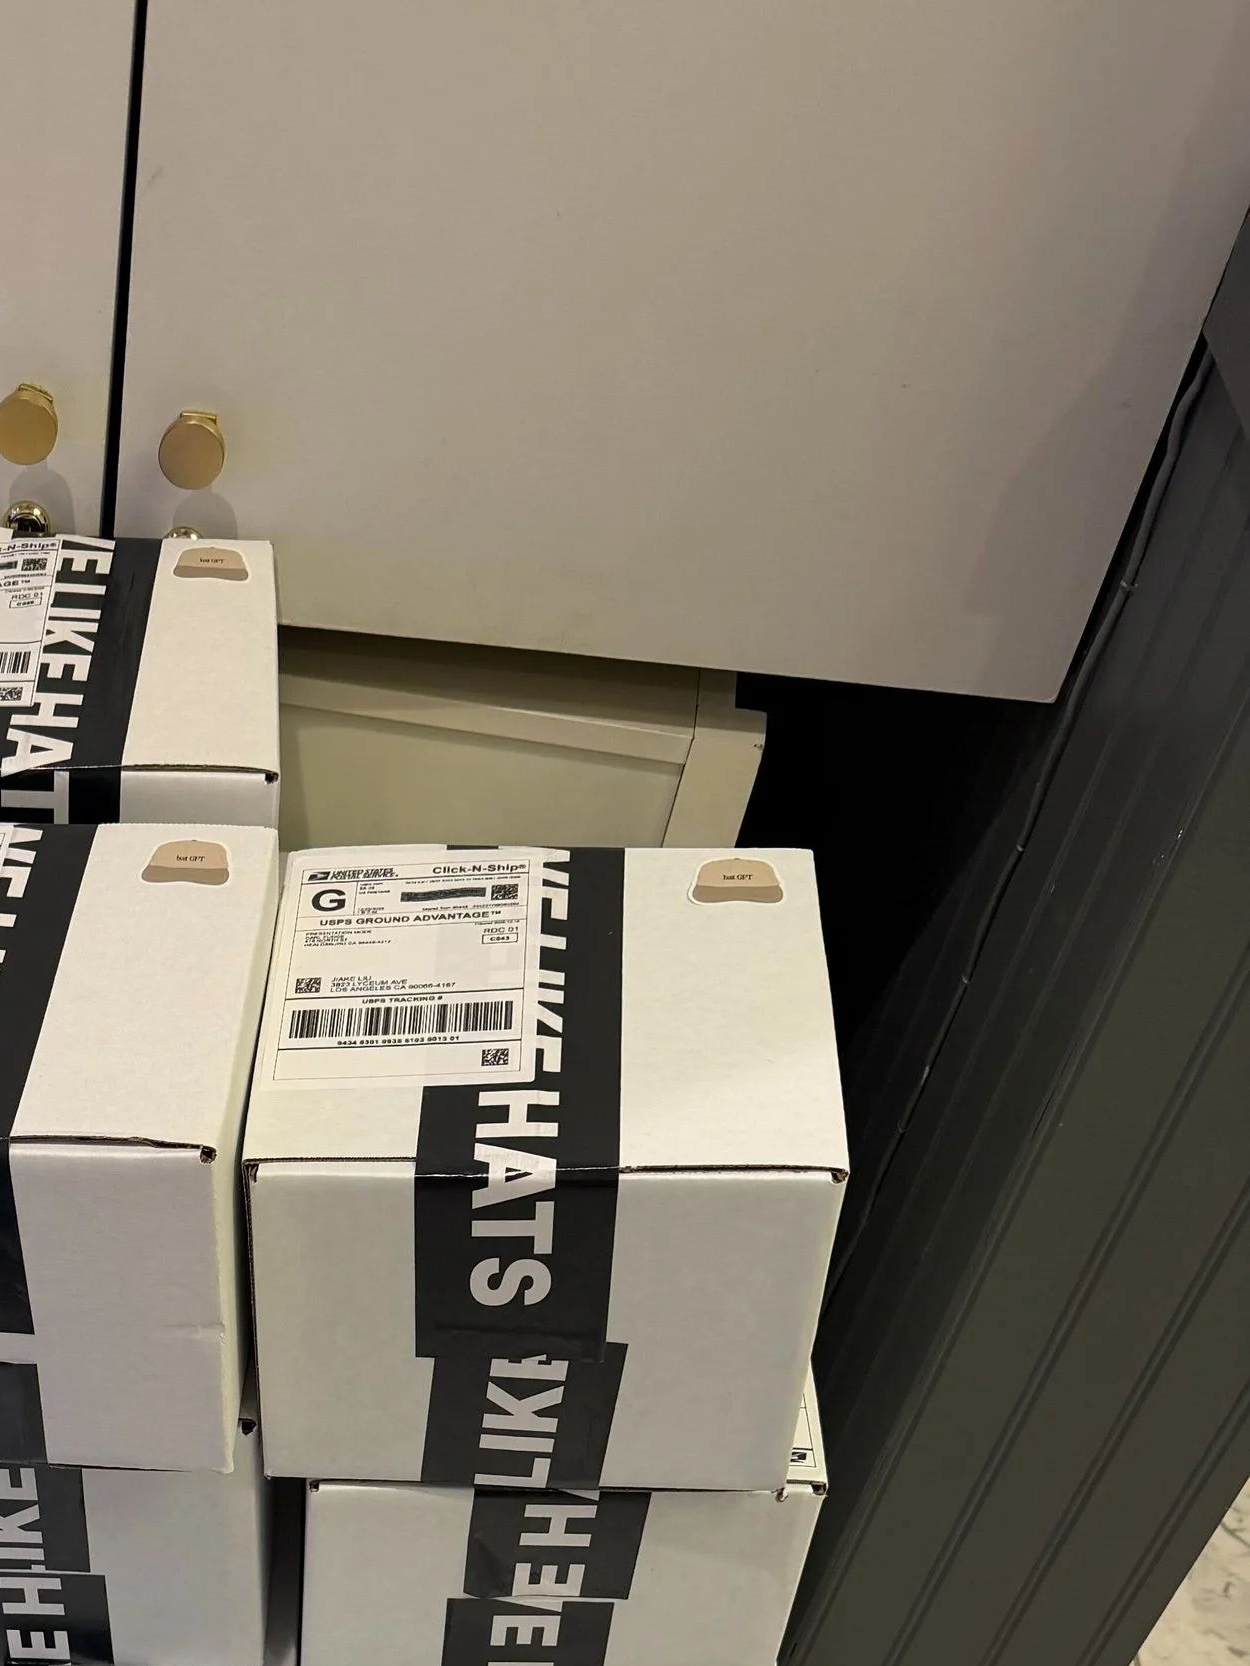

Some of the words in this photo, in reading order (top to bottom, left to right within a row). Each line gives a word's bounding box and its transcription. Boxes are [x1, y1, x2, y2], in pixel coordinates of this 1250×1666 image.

[310, 888, 347, 912] G
[319, 918, 353, 927] USPS
[355, 915, 410, 925] GROUND
[388, 995, 436, 1003] TRACKING
[469, 1089, 560, 1306] HATS
